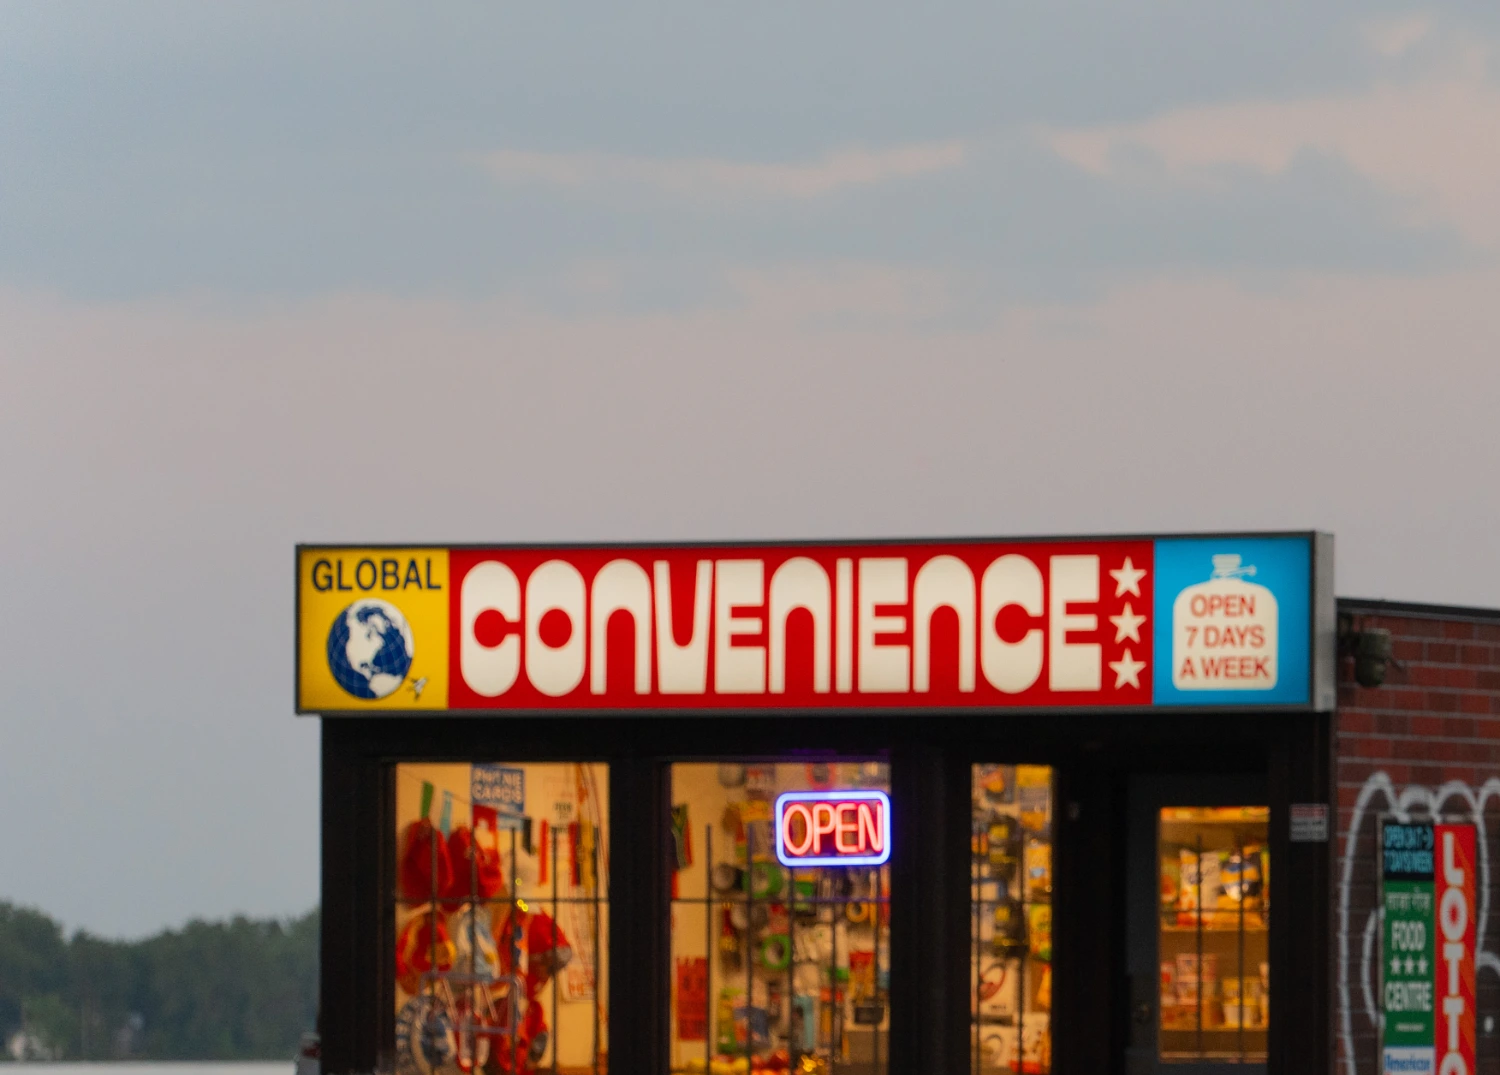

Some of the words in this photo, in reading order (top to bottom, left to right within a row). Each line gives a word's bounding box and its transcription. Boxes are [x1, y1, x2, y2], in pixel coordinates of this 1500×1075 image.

[311, 558, 442, 591] GLOBAL
[1190, 594, 1256, 618] OPEN
[460, 553, 1101, 697] CONVENIENCE
[1185, 625, 1198, 649] 7
[1203, 624, 1266, 649] DAYS
[1179, 656, 1197, 680] A
[1200, 656, 1271, 680] WEEK
[471, 782, 524, 805] CARDS
[783, 802, 883, 856] OPEN
[1391, 921, 1426, 951] FOOD
[1385, 981, 1432, 1012] CENTRE
[1384, 1053, 1430, 1072] American
